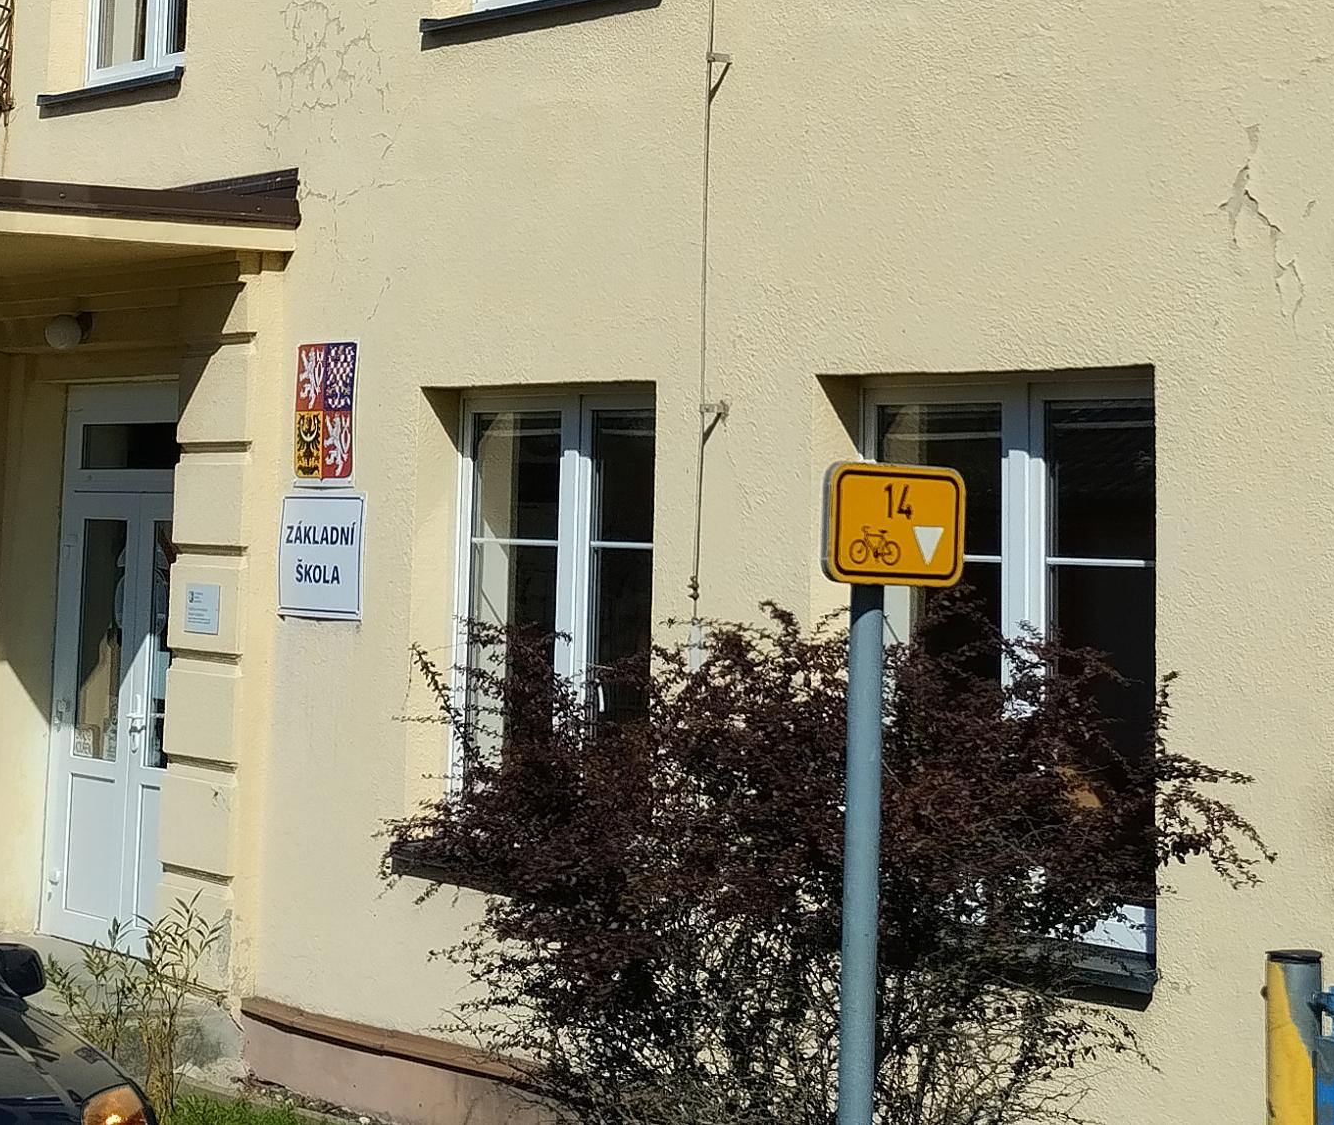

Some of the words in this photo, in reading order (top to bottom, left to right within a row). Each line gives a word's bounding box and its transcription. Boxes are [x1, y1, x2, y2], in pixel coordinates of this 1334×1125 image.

[884, 484, 912, 520] 14
[285, 520, 356, 546] ZÁKLADNÍ
[295, 558, 340, 584] ŠKOLA
